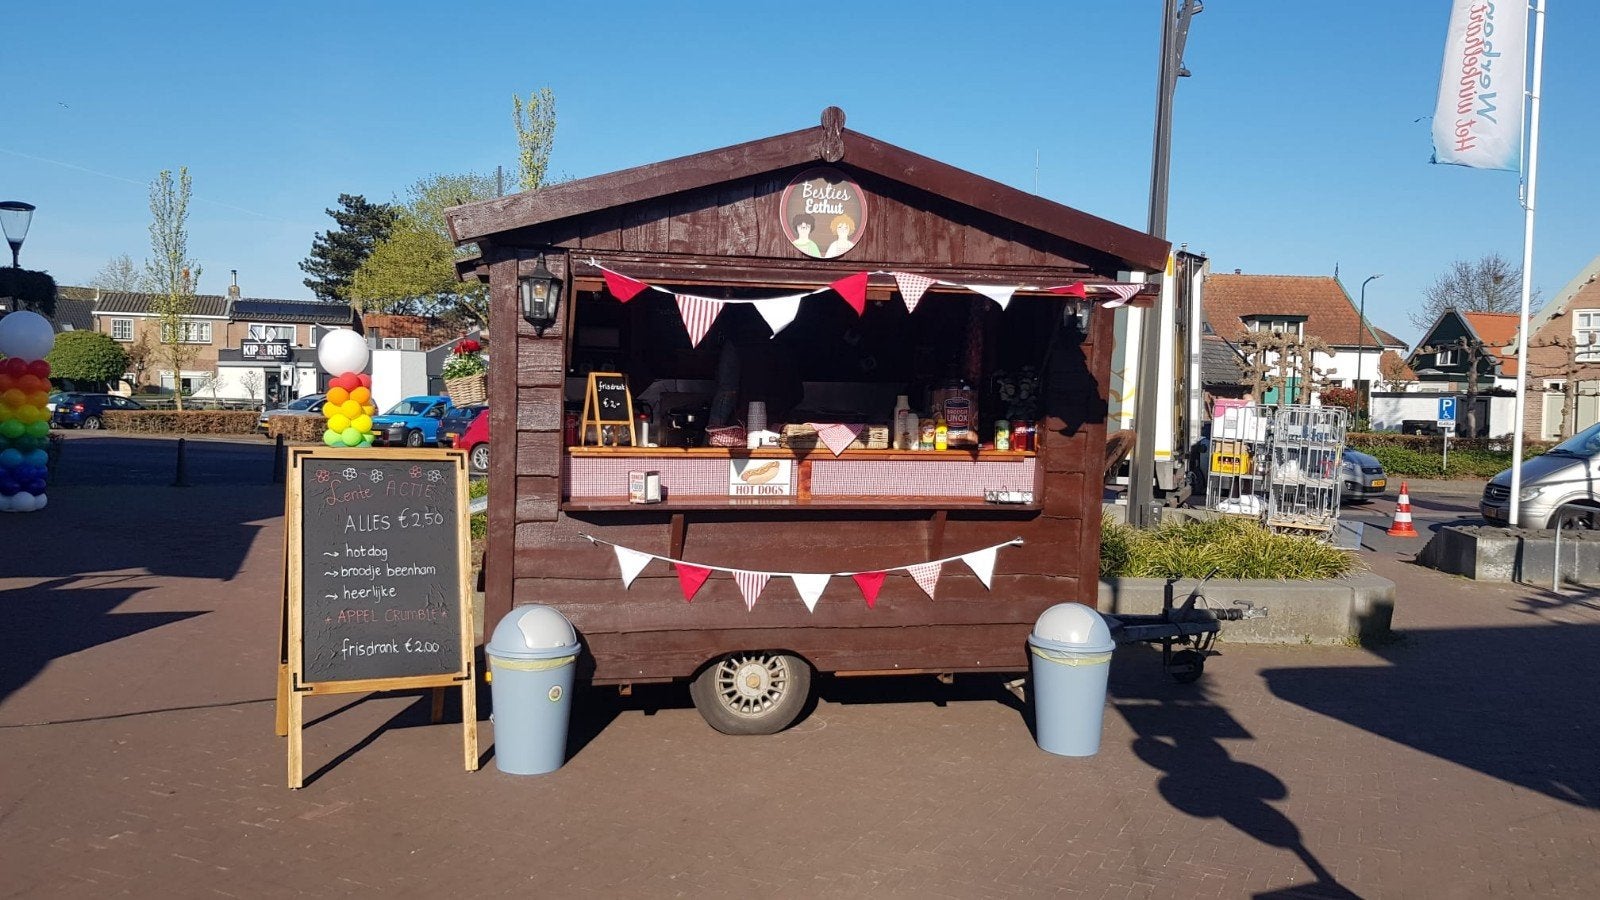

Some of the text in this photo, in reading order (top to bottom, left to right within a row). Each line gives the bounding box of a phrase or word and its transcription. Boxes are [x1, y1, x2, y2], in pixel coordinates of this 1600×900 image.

[802, 181, 851, 201] Besties
[806, 199, 844, 214] Eethut
[243, 344, 287, 355] KIP & RIBS
[598, 381, 626, 392] frisdrank
[1442, 399, 1452, 411] P
[947, 414, 968, 422] UNOX
[326, 480, 435, 505] Lente ACTIE
[735, 484, 784, 495] HOT DOGS
[344, 514, 391, 533] ALLES
[341, 562, 436, 581] broodje beenham
[343, 584, 397, 604] heerlijke
[338, 607, 378, 623] APPEL
[342, 637, 399, 660] frisdrank
